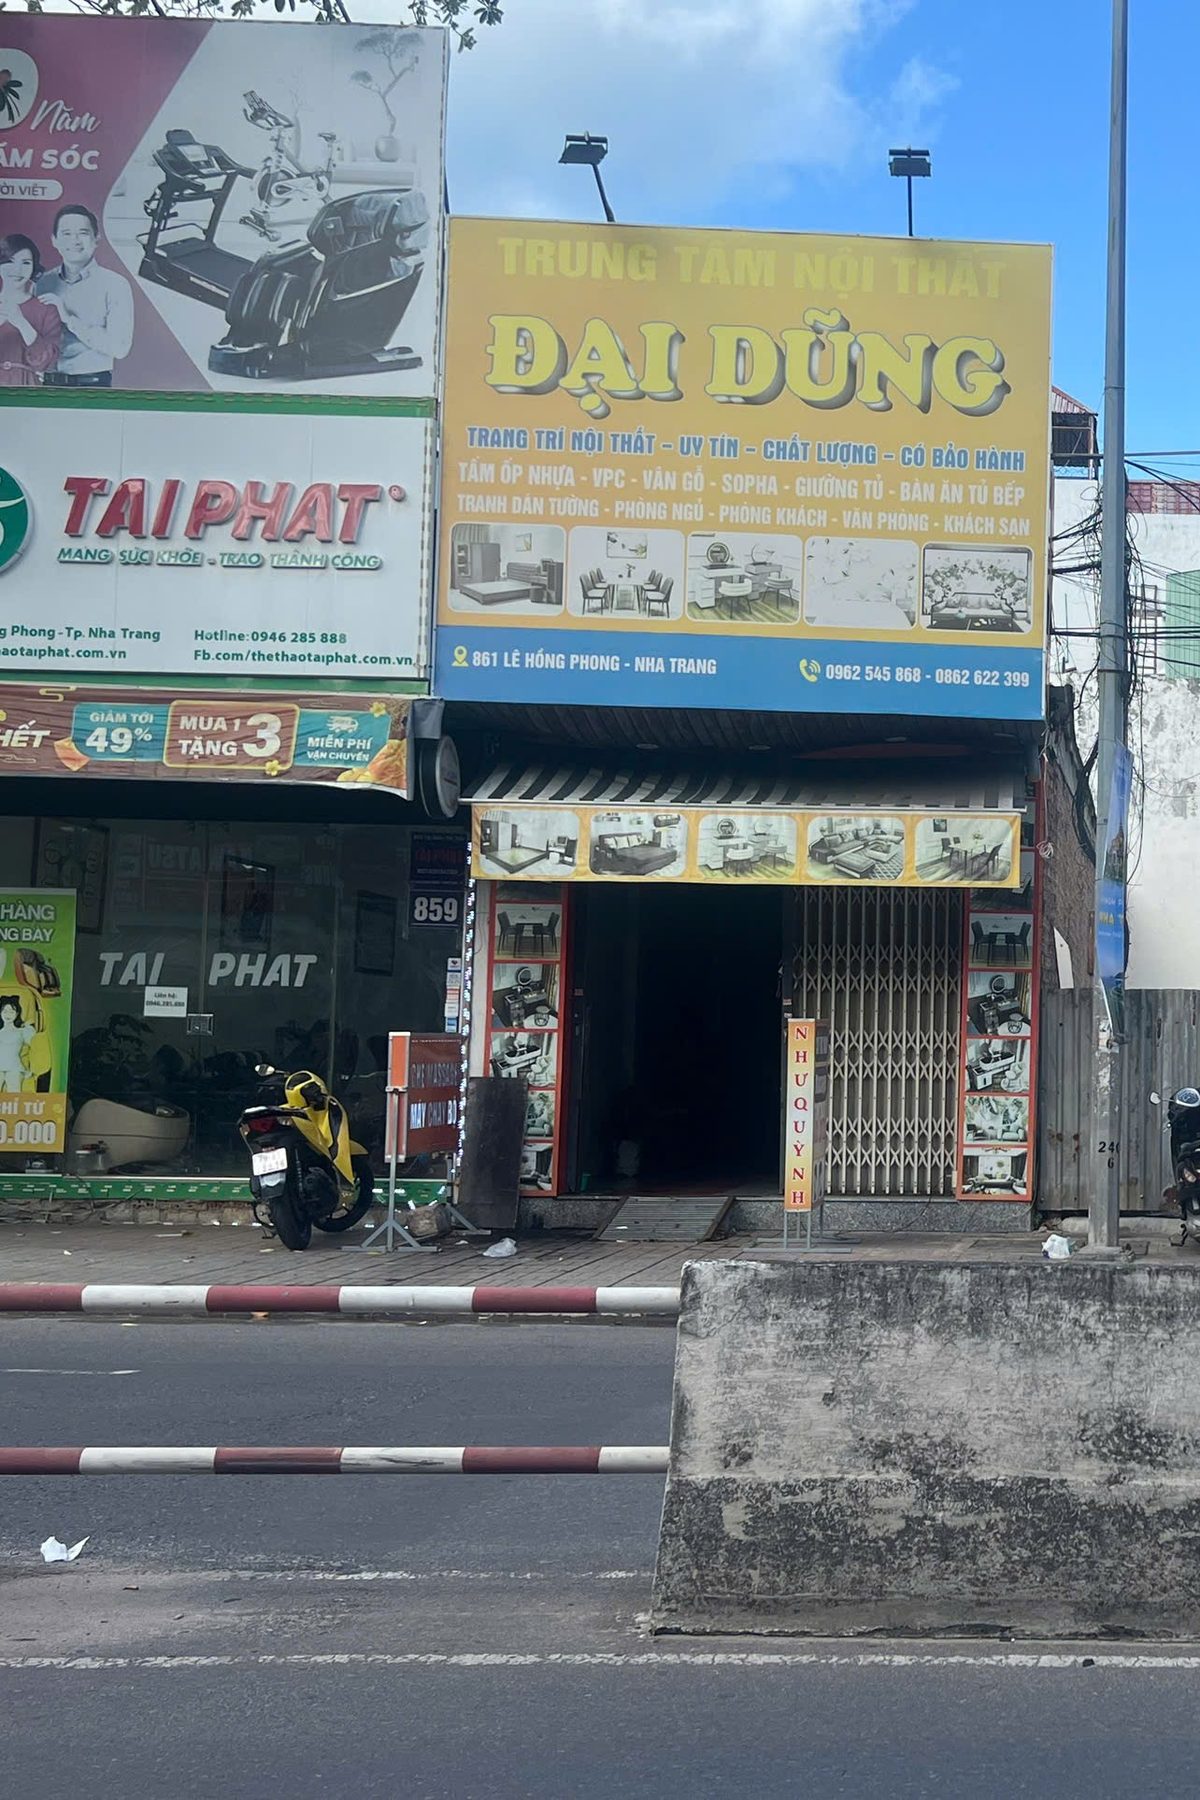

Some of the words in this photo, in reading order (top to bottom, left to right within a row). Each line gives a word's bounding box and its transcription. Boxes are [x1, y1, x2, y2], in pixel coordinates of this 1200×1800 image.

[30, 99, 101, 135] Năm
[40, 144, 100, 171] SÓC
[498, 237, 657, 282] TRUNG
[674, 239, 776, 287] TÂM
[793, 246, 874, 299] NỘI
[485, 313, 685, 418] ĐẠI
[705, 307, 1011, 416] DŨNG
[467, 426, 528, 449] TRANG
[535, 427, 564, 450] TRÍ
[571, 428, 604, 456] NỘI
[610, 426, 656, 455] THẤT
[679, 435, 704, 456] UY
[709, 434, 739, 458] TÍN
[763, 433, 810, 461] CHẤT
[816, 442, 877, 468] LƯỢNG
[901, 443, 926, 468] CÓ
[931, 441, 969, 470] BẢO
[975, 448, 1025, 471] HÀNH
[528, 463, 576, 490] NHỰA
[592, 467, 625, 489] VPC
[642, 466, 677, 491] VÂN
[722, 472, 778, 496] SOPHA
[796, 472, 858, 499] GIƯỜNG
[863, 473, 884, 500] TỦ
[940, 480, 964, 504] ĂN
[993, 480, 1026, 507] BẾP
[64, 476, 184, 539] TAI
[184, 480, 384, 546] PHAT
[456, 493, 508, 514] TRANH
[548, 493, 599, 517] TƯỜNG
[614, 496, 667, 521] PHÒNG
[776, 504, 828, 528] KHÁCH
[842, 507, 873, 530] VĂN
[944, 512, 995, 535] KHÁCH
[999, 518, 1030, 540] SẠN
[219, 552, 263, 568] TRAO
[11, 625, 56, 640] Phong
[88, 627, 116, 639] Nha
[121, 628, 161, 642] Trang
[290, 632, 317, 643] 285
[320, 634, 348, 644] 888
[472, 651, 498, 667] 861
[504, 649, 521, 668] LÊ
[525, 648, 566, 670] HỒNG
[570, 654, 620, 672] PHONG
[635, 657, 665, 673] NHA
[669, 657, 717, 675] TRANG
[826, 664, 861, 681] 0962
[864, 666, 891, 682] 545
[895, 667, 921, 683] 868
[935, 668, 970, 685] 0862
[974, 670, 1000, 686] 622
[1004, 671, 1029, 688] 399
[178, 739, 238, 759] TẶNG
[243, 713, 282, 757] 3
[349, 736, 373, 750] PHÍ
[179, 715, 228, 731] MUA
[233, 718, 240, 731] 1
[0, 900, 56, 920] HÀNG
[413, 897, 458, 923] 859
[100, 952, 165, 985] TAI
[208, 952, 318, 987] PHAT
